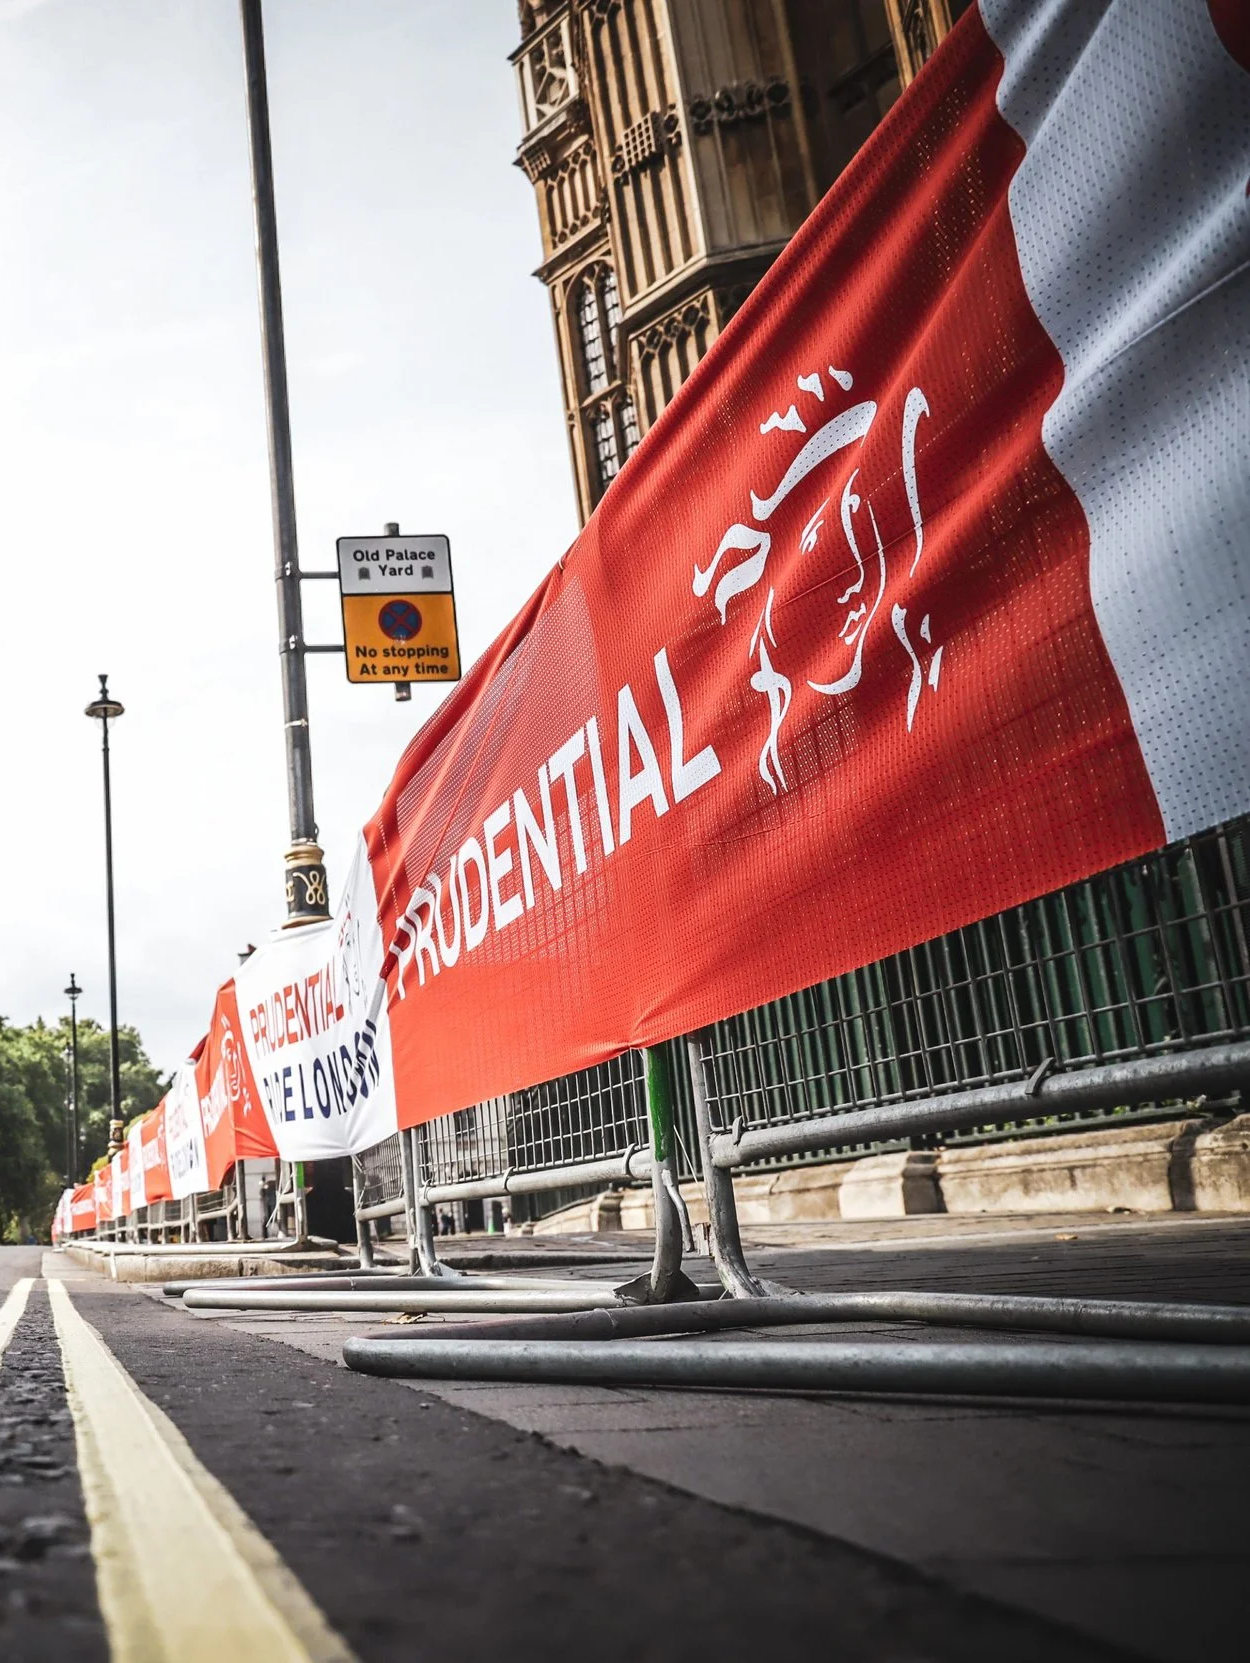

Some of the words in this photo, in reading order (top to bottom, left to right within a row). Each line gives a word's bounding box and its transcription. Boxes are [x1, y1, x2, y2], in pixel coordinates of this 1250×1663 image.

[353, 550, 379, 562] Old
[386, 548, 435, 561] Palace
[378, 565, 413, 576] Yard
[355, 645, 377, 658] No
[383, 645, 449, 659] stopping
[359, 663, 377, 675] At
[382, 665, 409, 677] any
[415, 662, 448, 674] time
[390, 647, 721, 999] PRUDENTIAL
[249, 956, 344, 1060] PRUDENTIAL
